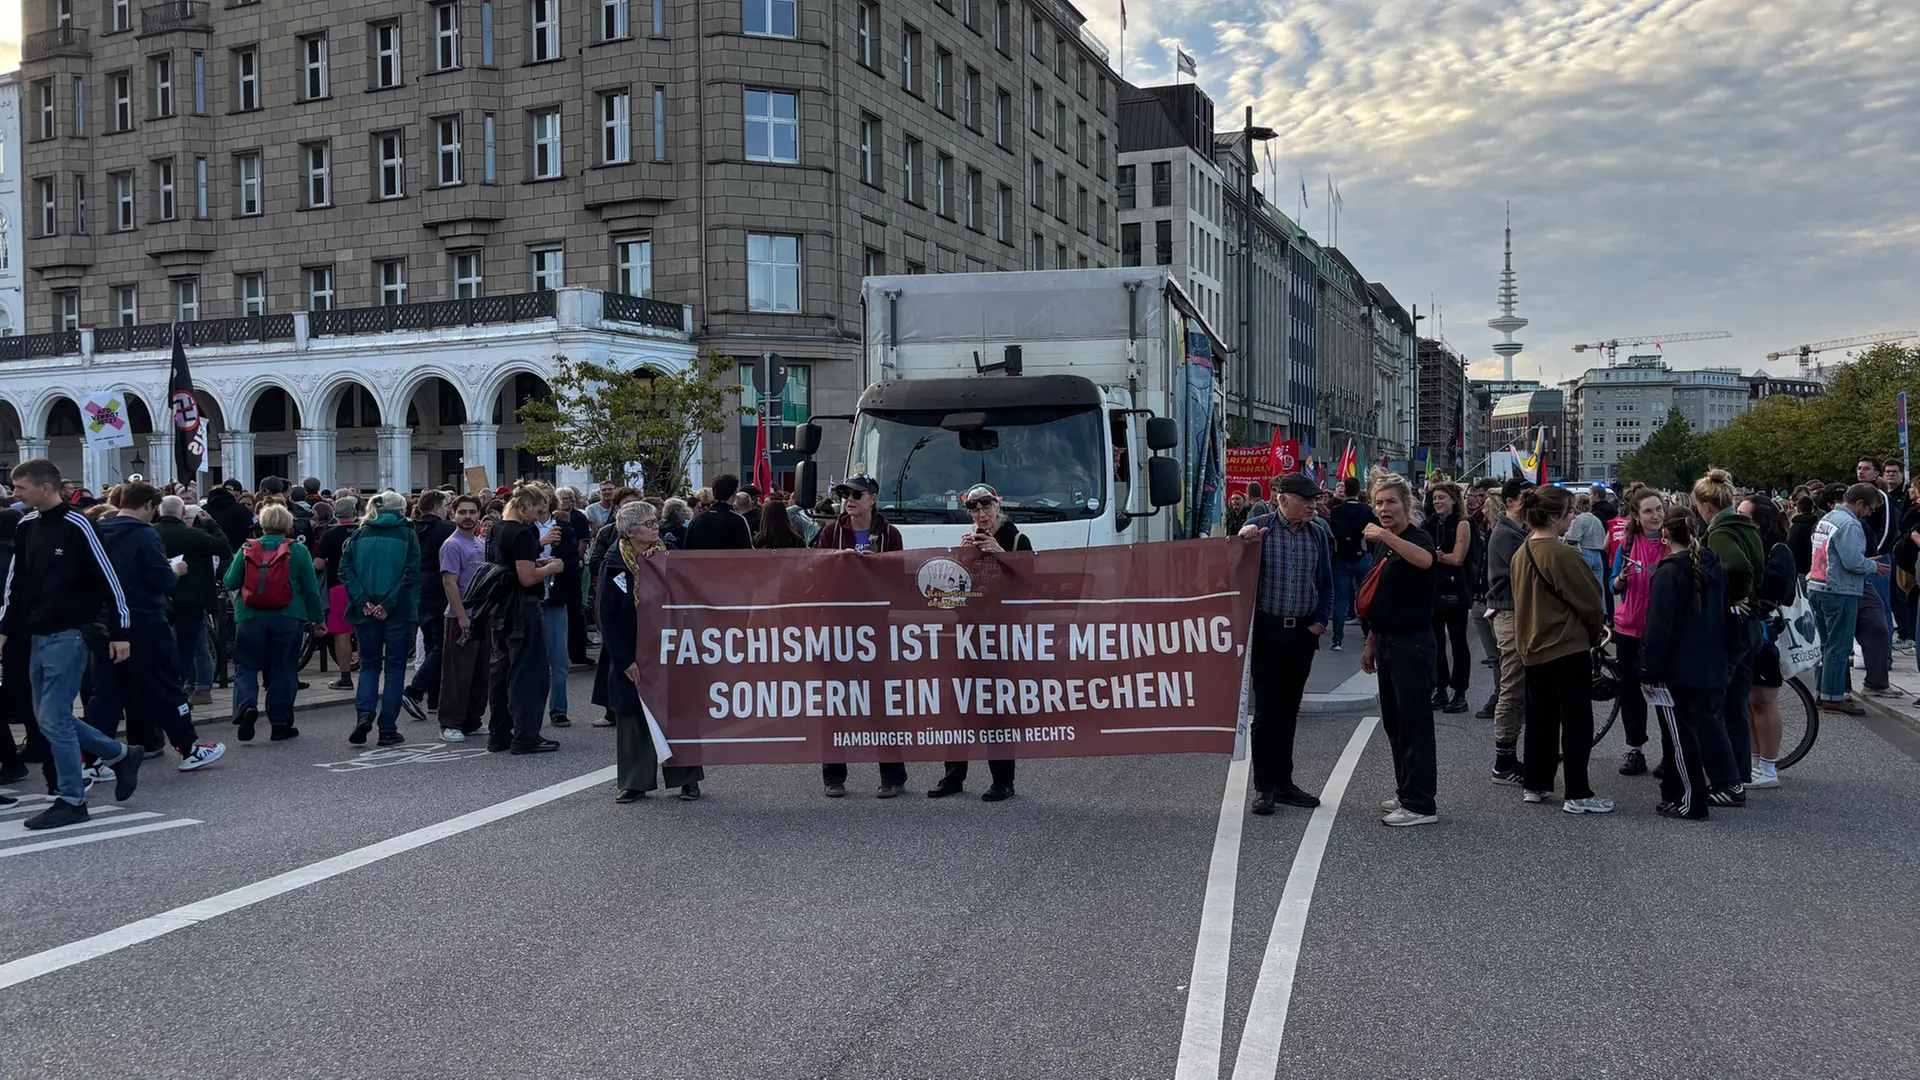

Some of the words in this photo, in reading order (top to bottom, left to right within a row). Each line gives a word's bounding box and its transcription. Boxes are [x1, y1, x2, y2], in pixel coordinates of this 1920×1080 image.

[659, 625, 878, 665] FASCHISMUS
[889, 623, 943, 661] IST
[955, 623, 1056, 661] KEINE
[1069, 615, 1244, 661] MEINUNG,
[708, 680, 871, 719] SONDERN
[884, 677, 941, 716] EIN
[951, 671, 1195, 715] VERBRECHEN!
[833, 731, 913, 747] HAMBURGER
[916, 728, 976, 746] BÜNDNIS
[979, 728, 1021, 744] GEGEN
[1024, 726, 1076, 742] RECHTS
